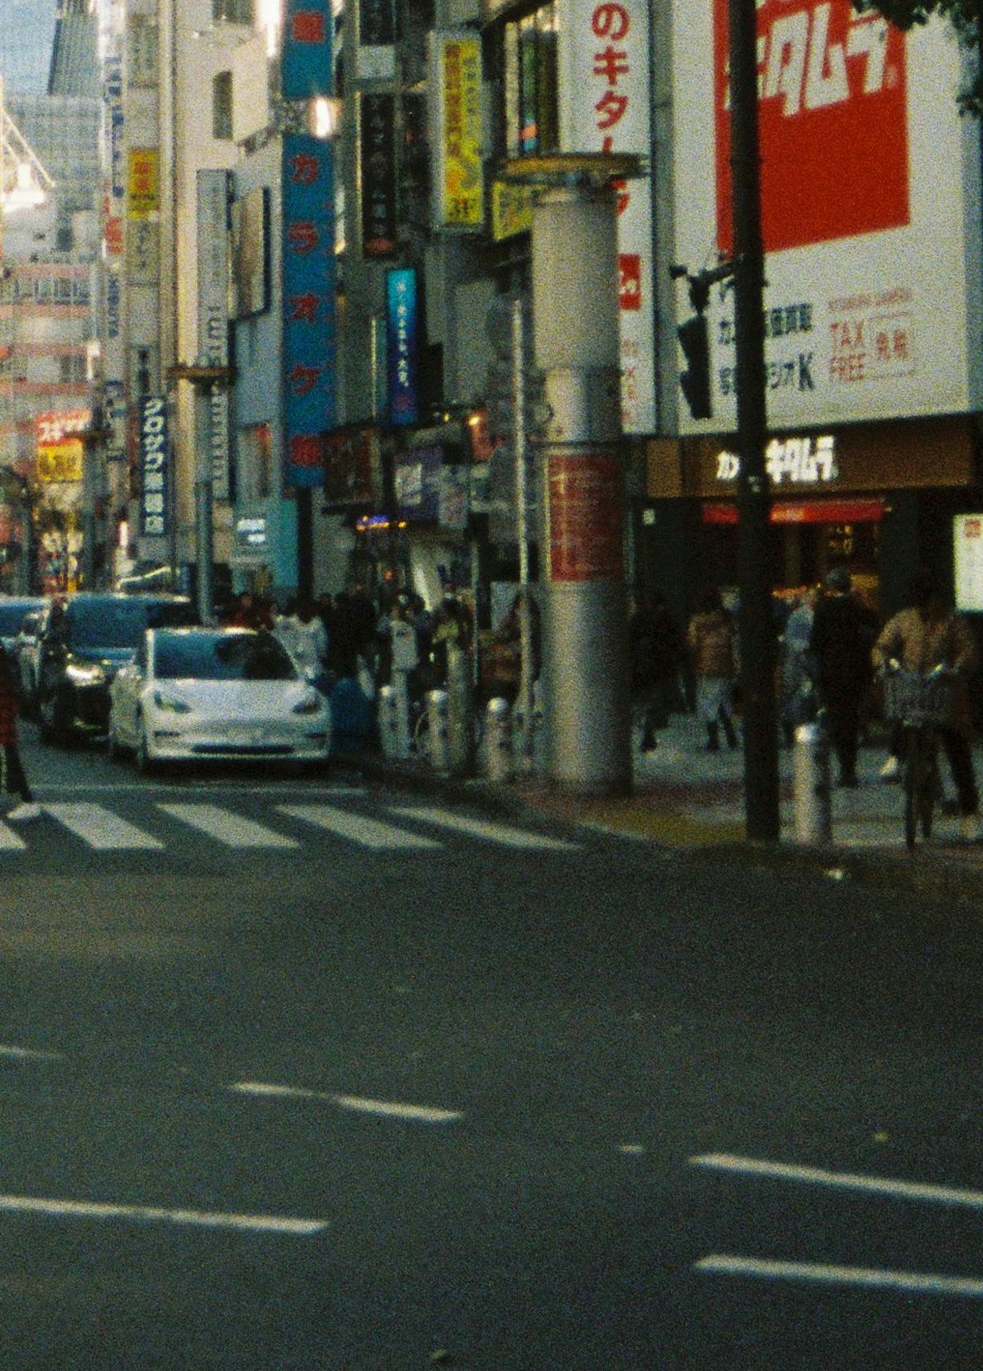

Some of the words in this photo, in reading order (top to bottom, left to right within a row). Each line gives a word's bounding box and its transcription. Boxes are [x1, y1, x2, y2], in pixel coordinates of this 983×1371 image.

[725, 2, 889, 117] タムラ
[288, 151, 322, 467] カラオケ館
[716, 450, 741, 480] カ
